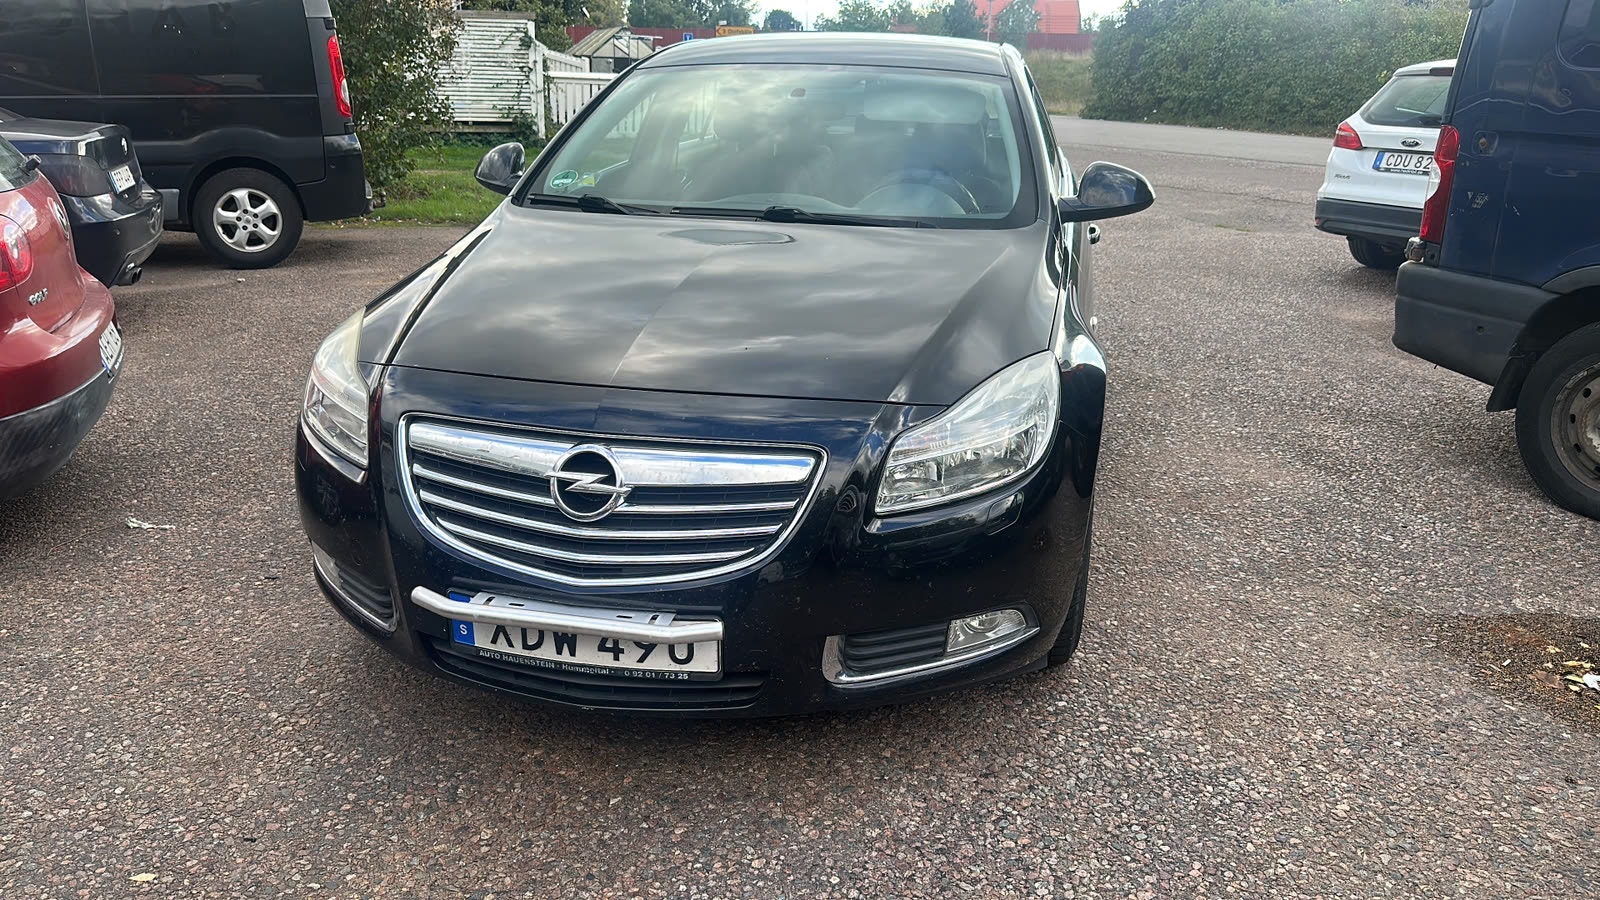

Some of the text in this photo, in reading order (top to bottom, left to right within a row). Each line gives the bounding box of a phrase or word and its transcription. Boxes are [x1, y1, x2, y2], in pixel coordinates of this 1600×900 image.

[1386, 153, 1434, 170] CDU 82
[28, 287, 49, 306] GOLF
[459, 623, 468, 635] S
[479, 650, 501, 660] AUTO
[502, 654, 555, 669] HAUENSTEIN
